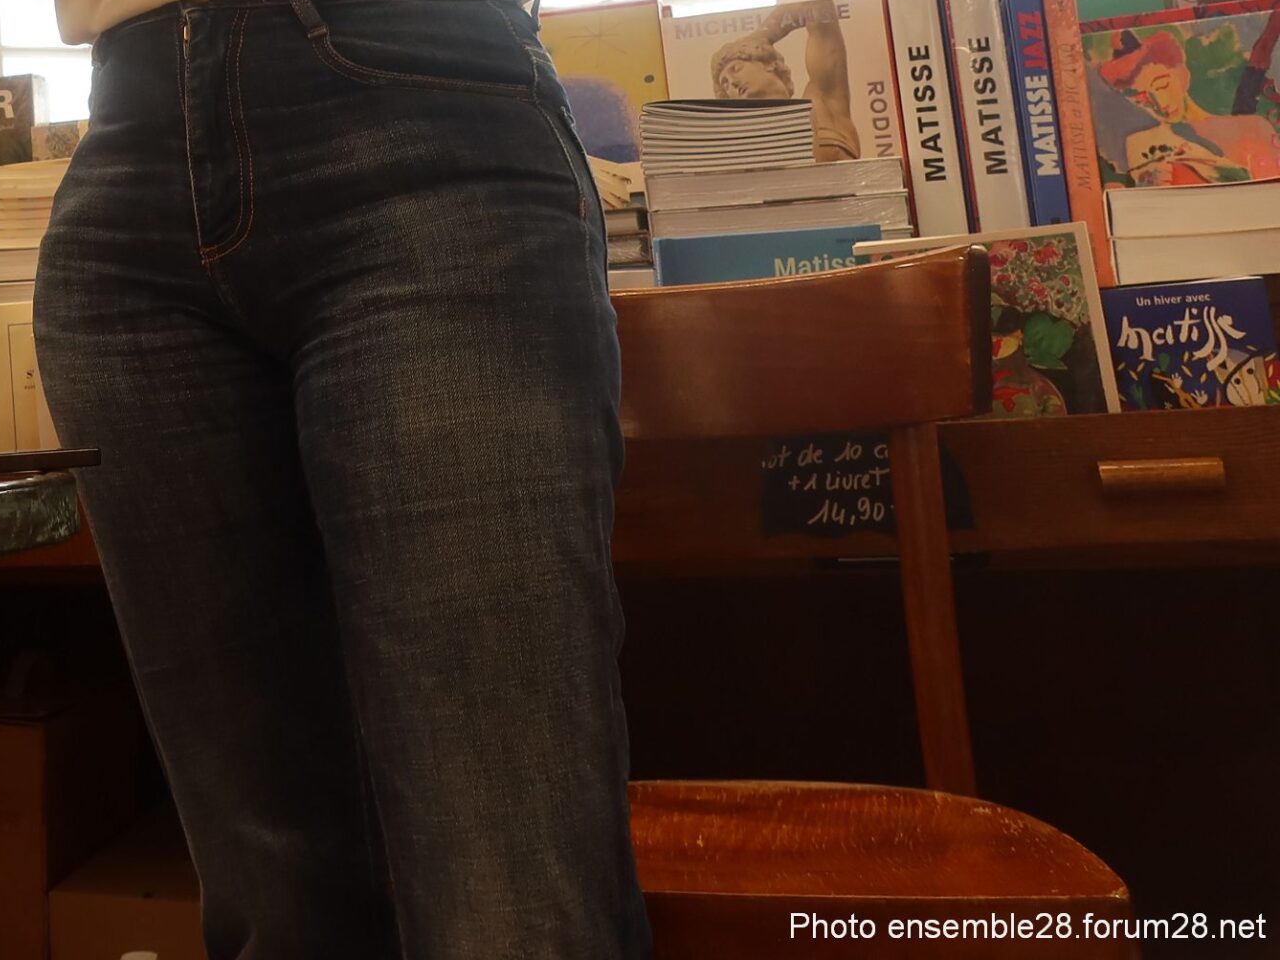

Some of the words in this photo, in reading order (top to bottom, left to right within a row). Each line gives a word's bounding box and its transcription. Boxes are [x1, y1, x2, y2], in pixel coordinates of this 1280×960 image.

[1016, 11, 1047, 70] JAZZ
[866, 81, 897, 159] RODIN
[909, 45, 946, 182] MATISSE
[968, 37, 1008, 175] MATISSE
[1024, 75, 1061, 176] MATISSE
[1066, 122, 1092, 190] MATISSE
[1136, 297, 1150, 307] Un
[1154, 294, 1182, 306] hiver
[1186, 293, 1211, 303] avec
[762, 445, 792, 468] ot
[797, 444, 823, 467] de
[834, 442, 862, 462] 10
[808, 497, 885, 525] 14,90
